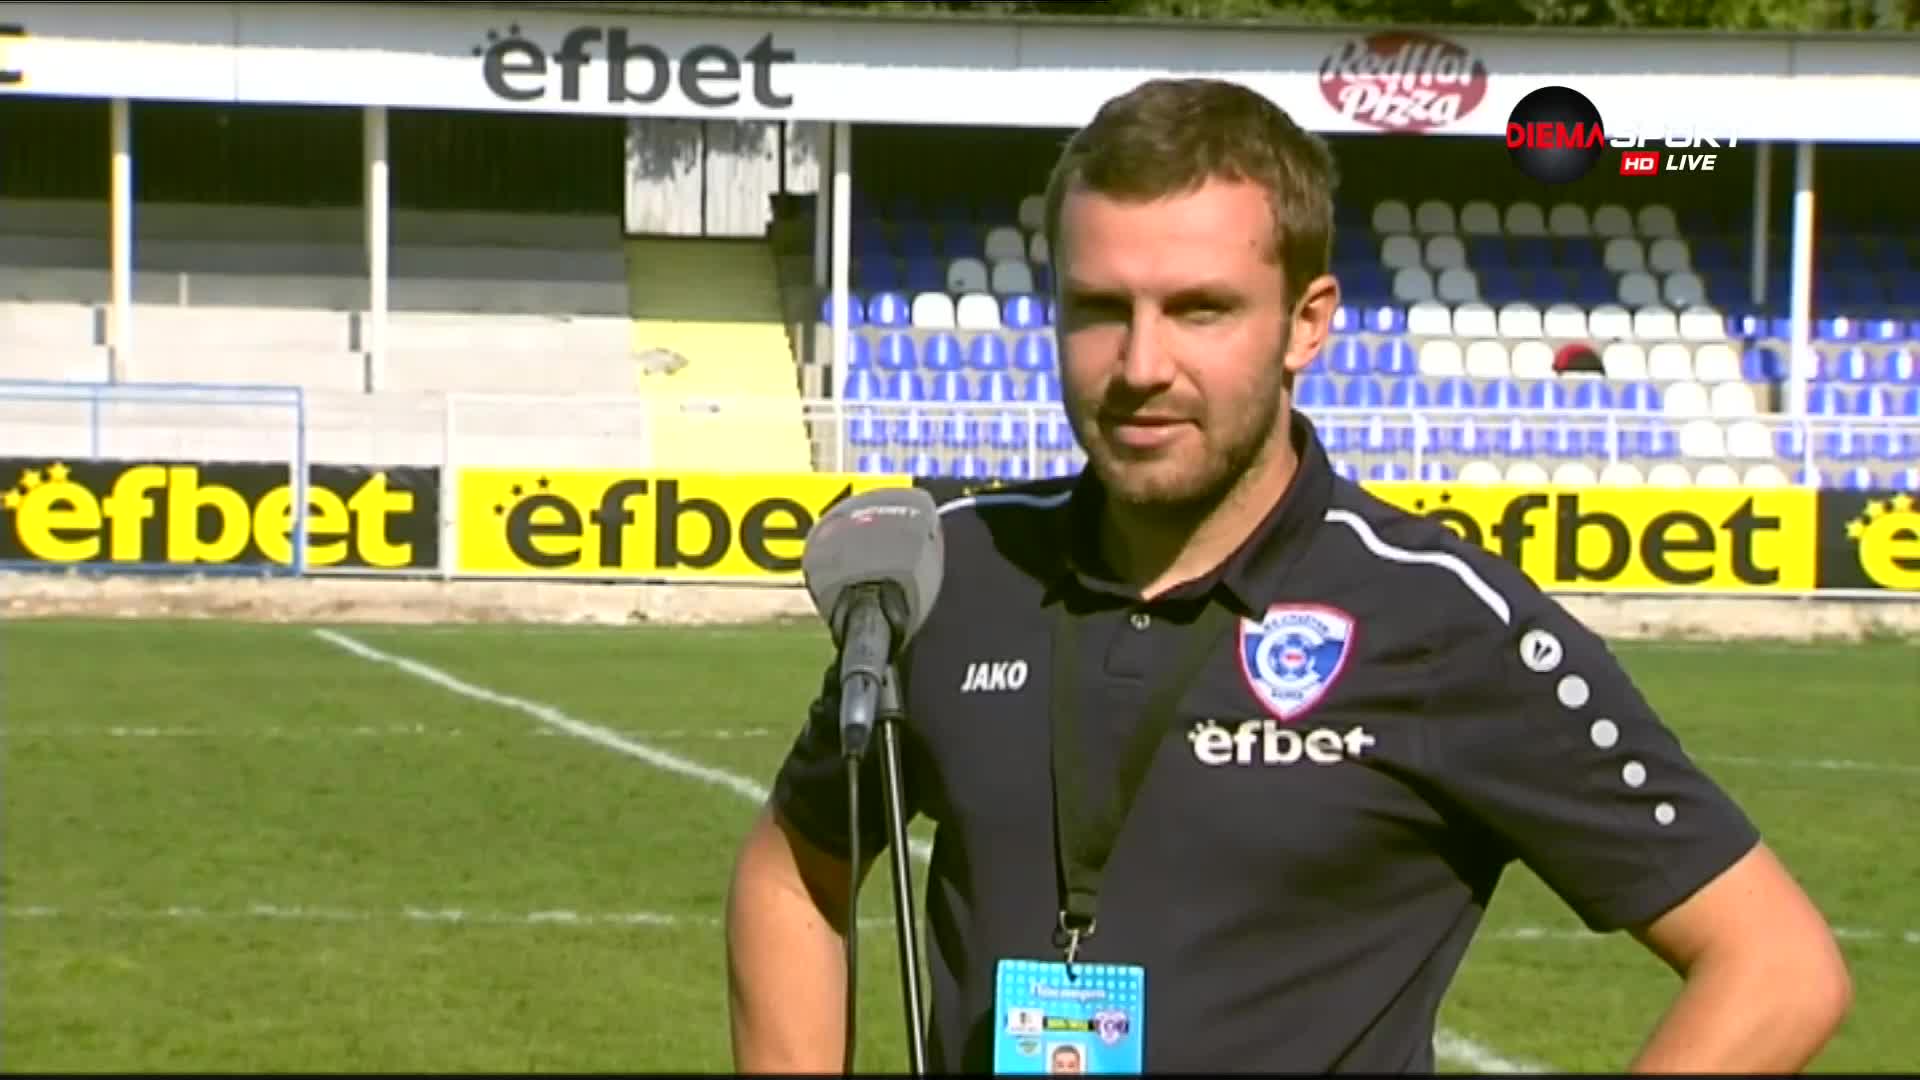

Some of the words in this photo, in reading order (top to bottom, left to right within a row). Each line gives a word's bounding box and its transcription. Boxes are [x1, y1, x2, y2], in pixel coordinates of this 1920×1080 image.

[474, 19, 795, 108] efbet
[1338, 80, 1462, 127] Pizza
[4, 462, 415, 568] efbet
[496, 477, 853, 573] efbe
[960, 660, 1028, 692] JAKO
[1188, 719, 1376, 765] efbet
